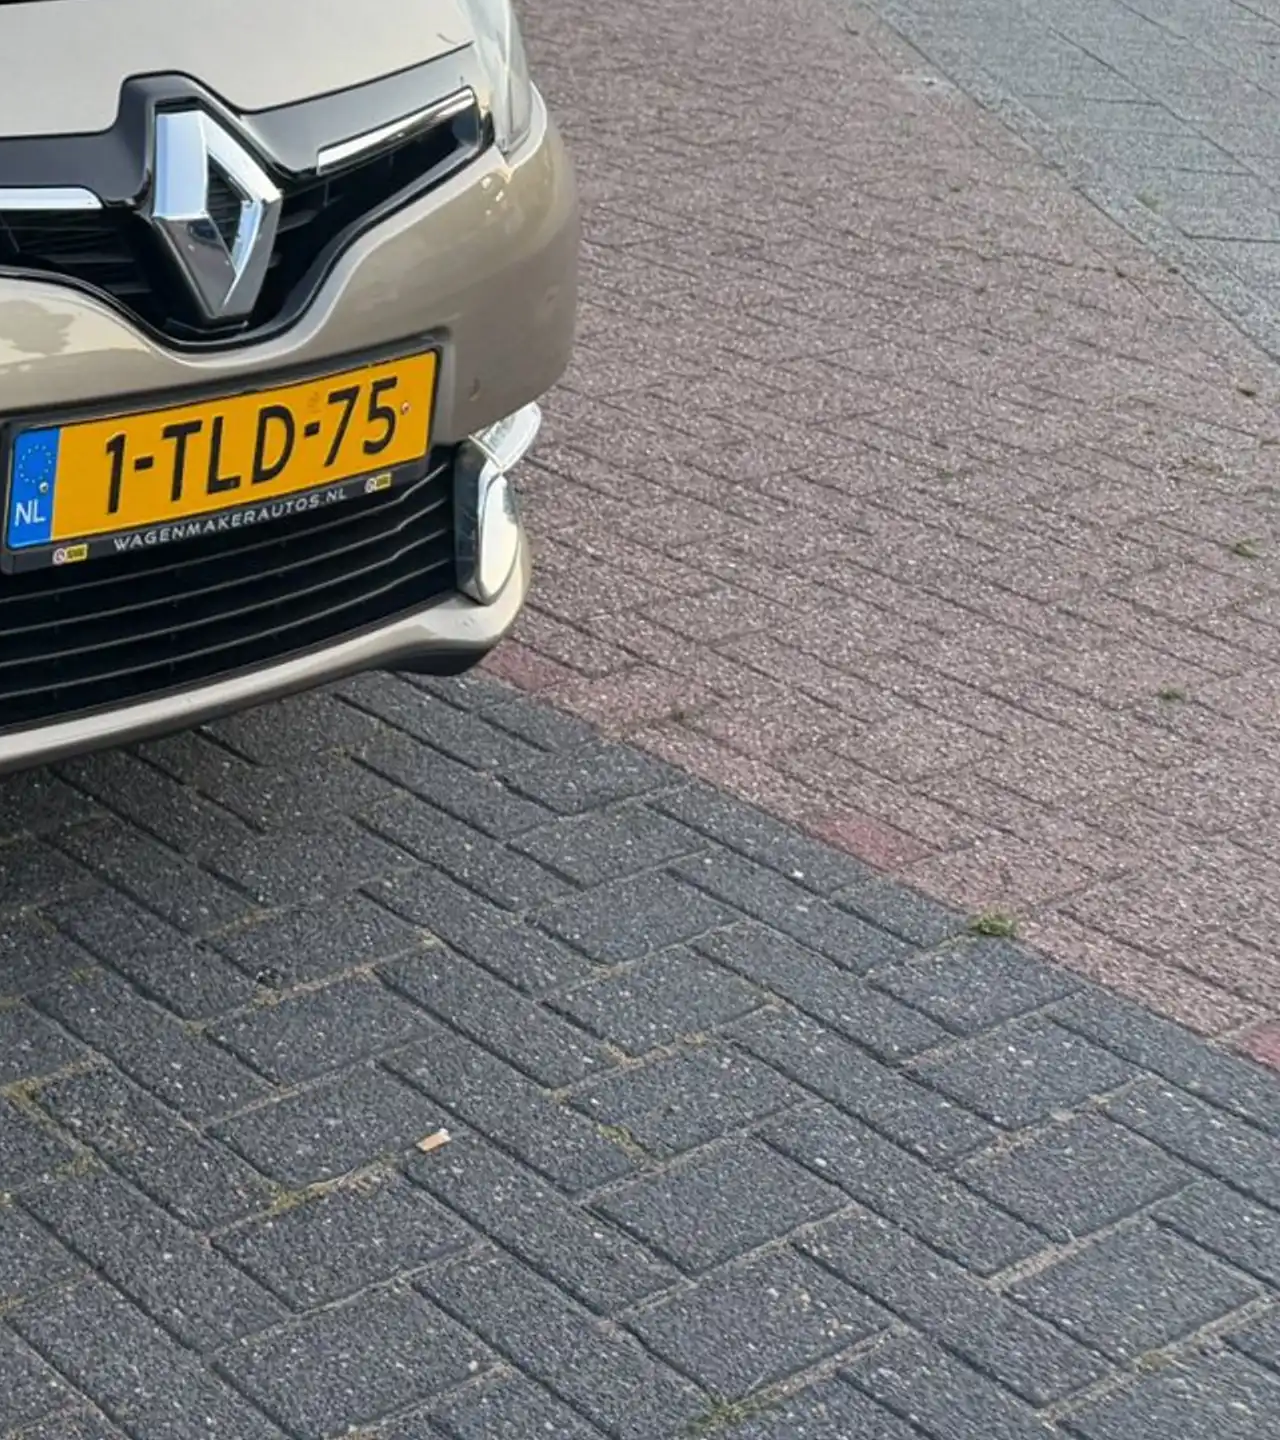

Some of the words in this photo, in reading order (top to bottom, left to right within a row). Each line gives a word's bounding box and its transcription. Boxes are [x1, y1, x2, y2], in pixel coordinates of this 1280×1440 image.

[105, 376, 397, 515] 1-TLD-75
[14, 499, 45, 528] NL
[113, 487, 347, 552] WAGENMAKERAUTOS.NL
